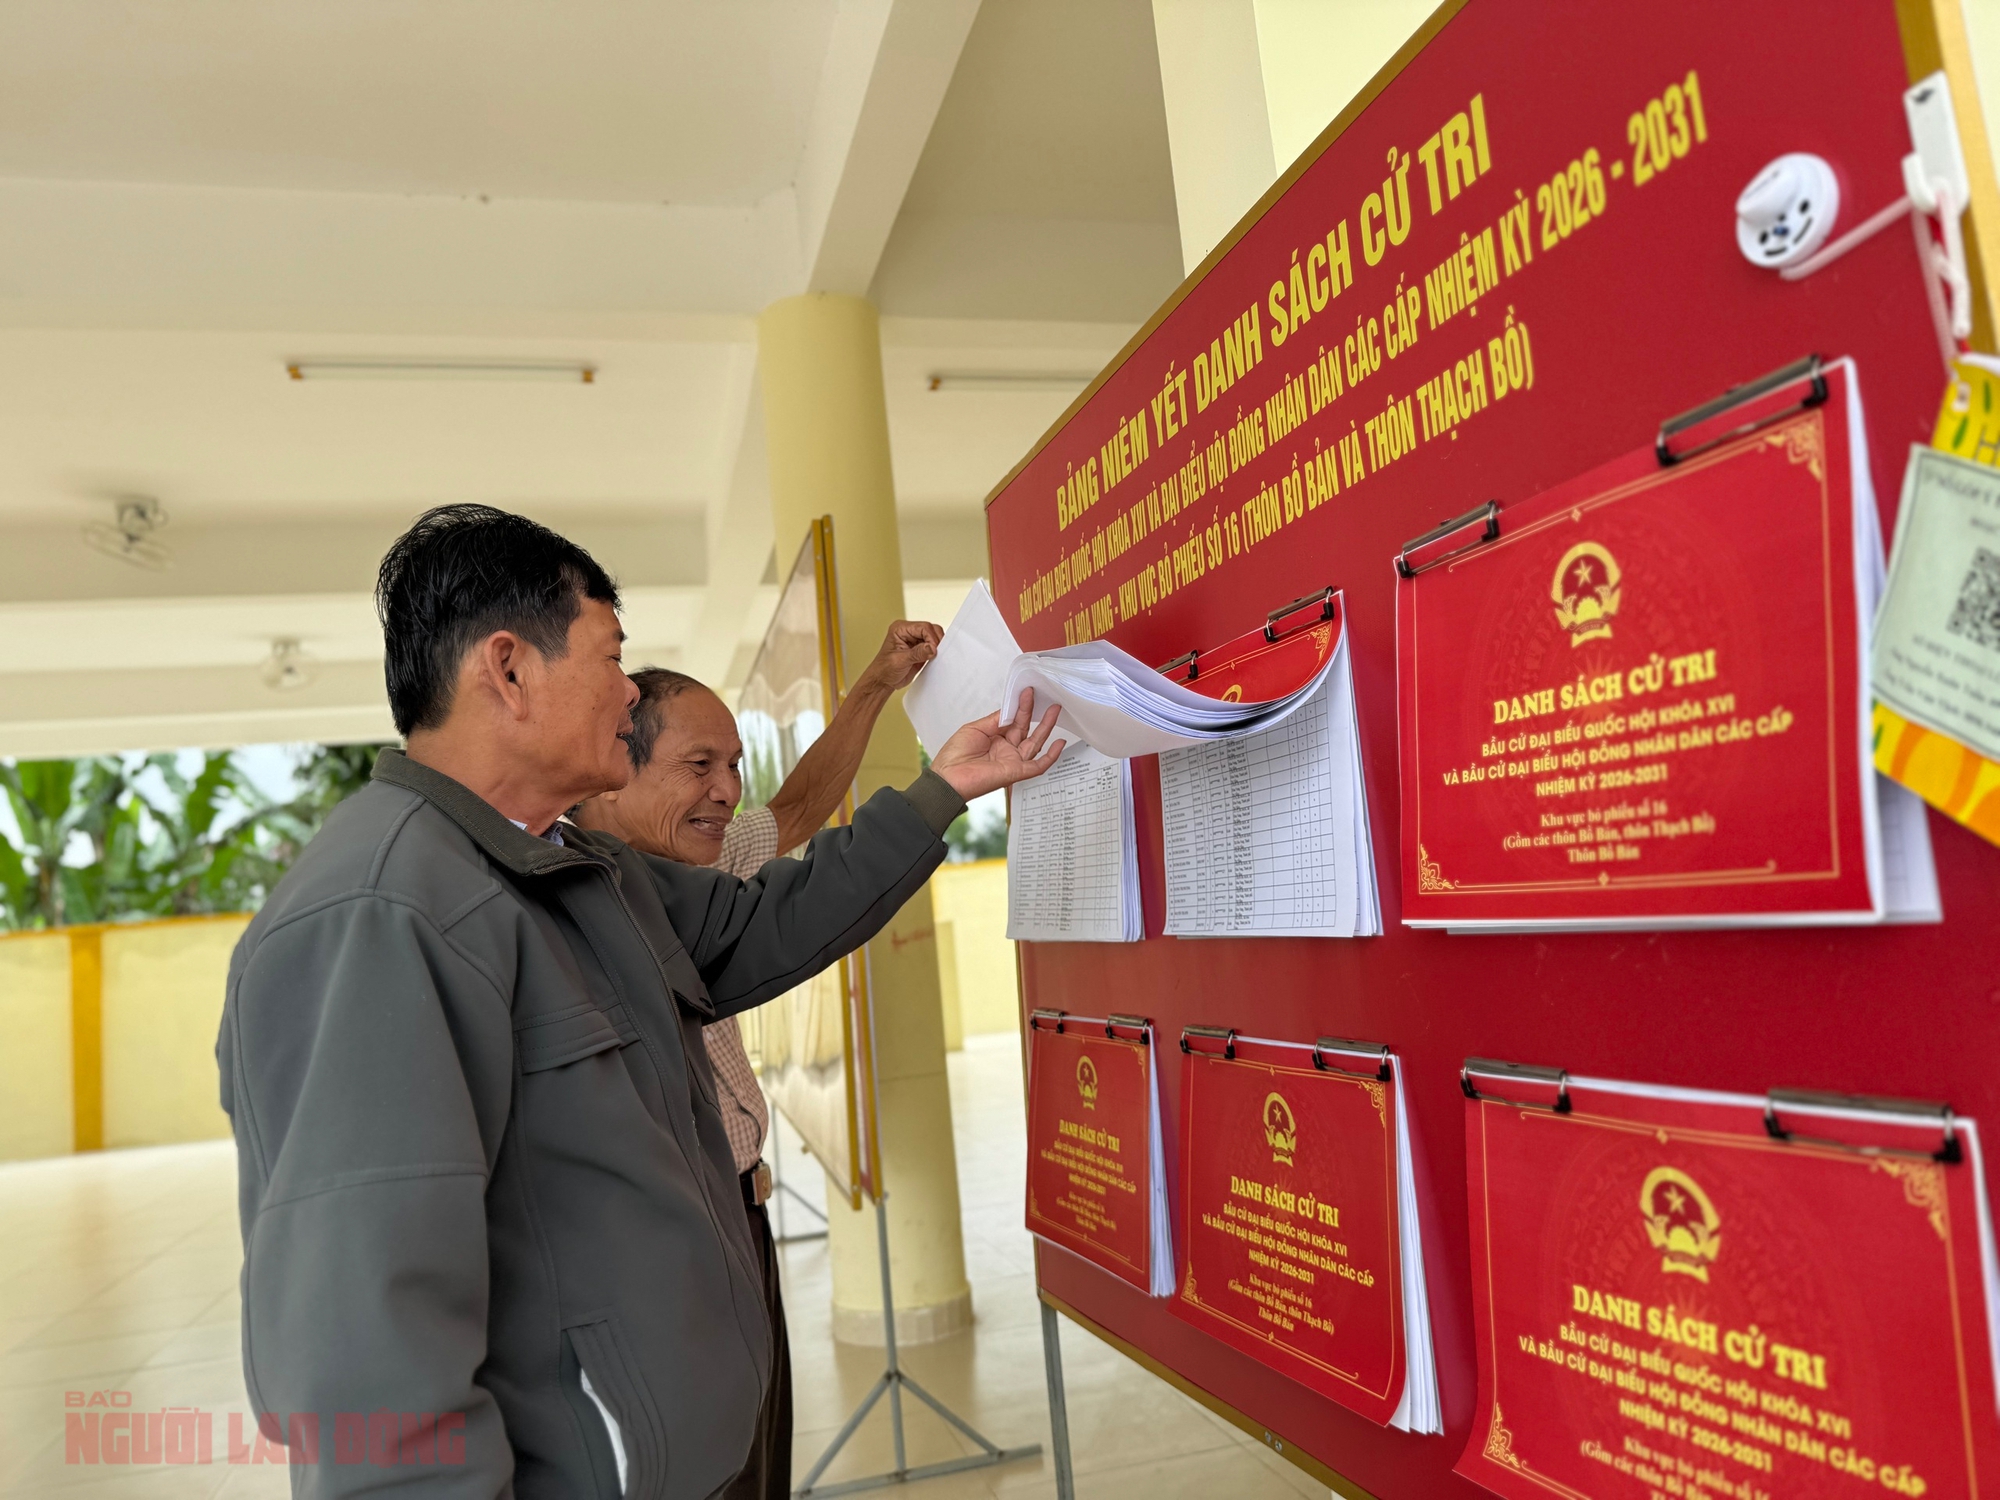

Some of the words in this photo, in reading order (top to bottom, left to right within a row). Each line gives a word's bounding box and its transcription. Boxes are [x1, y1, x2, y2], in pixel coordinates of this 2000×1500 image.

[1057, 457, 1099, 531] BẢNG
[1101, 408, 1149, 493] NIÊM
[1151, 361, 1187, 447] YẾT
[1194, 302, 1262, 414] DANH
[1269, 219, 1352, 346] SÁCH
[1360, 146, 1411, 266] CỬ
[1418, 94, 1491, 215] TRI
[1071, 534, 1092, 590] QUỐC
[1092, 526, 1107, 576] HỘI
[1106, 509, 1131, 562] KHÓA
[1130, 500, 1147, 544] XVI
[1146, 482, 1161, 532] VÀ
[1161, 474, 1180, 526] ĐẠI
[1180, 440, 1206, 508] BIỂU
[1206, 430, 1228, 492] HỘI
[1228, 406, 1265, 473] ĐỒNG
[1266, 373, 1307, 446] NHÂN
[1308, 346, 1343, 415] DÂN
[1345, 315, 1380, 387] CÁC
[1384, 272, 1420, 359] CẤP
[1425, 227, 1498, 330] NHIỆM
[1499, 189, 1532, 276] KỲ
[1537, 148, 1606, 250] 2026
[1628, 72, 1706, 186] 2031
[1075, 603, 1092, 644] HÒA
[1091, 594, 1113, 638] VANG
[1119, 578, 1138, 622] KHU
[1138, 564, 1157, 615] VỰC
[1158, 542, 1172, 599] BỎ
[1173, 524, 1205, 590] PHIẾU
[1206, 506, 1222, 570] SỐ
[1224, 512, 1240, 558] 16
[1242, 481, 1282, 553] (THÔN
[1282, 452, 1303, 524] BỒ
[1305, 438, 1339, 510] BẢN
[1339, 420, 1365, 488] VÀ
[1365, 394, 1416, 472] THÔN
[1416, 349, 1488, 442] THẠCH
[1488, 306, 1533, 400] BỒ)
[1482, 736, 1505, 756] BẦU
[1508, 732, 1526, 752] CỬ
[1529, 732, 1551, 750] ĐẠI
[1554, 720, 1581, 744] BIỂU
[1584, 714, 1625, 738] QUỐC
[1628, 708, 1656, 732] HỘI
[1658, 700, 1704, 725] KHÓA
[1707, 694, 1735, 716] XVI
[1494, 689, 1555, 724] DANH
[1560, 672, 1622, 710] SÁCH
[1628, 654, 1665, 695] CỬ
[1669, 650, 1716, 686] TRI
[1443, 769, 1459, 785] VÀ
[1462, 763, 1485, 783] BẦU
[1488, 760, 1506, 779] CỬ
[1508, 760, 1530, 778] ĐẠI
[1532, 750, 1558, 772] BIỂU
[1562, 748, 1586, 770] HỘI
[1588, 740, 1632, 764] ĐỒNG
[1633, 733, 1676, 756] NHÂN
[1678, 726, 1713, 750] DÂN
[1715, 718, 1753, 743] CÁC
[1755, 706, 1793, 736] CẤP
[1536, 776, 1576, 797] NHIỆM
[1578, 772, 1596, 791] KỲ
[1599, 764, 1667, 789] 2026-2031
[1231, 1176, 1262, 1202] DANH
[1265, 1184, 1295, 1212] SÁCH
[1298, 1192, 1316, 1218] CỬ
[1317, 1203, 1338, 1227] TRI
[1249, 1249, 1269, 1266] NHIỆM
[1269, 1256, 1279, 1270] KỲ
[1280, 1262, 1314, 1284] 2026-2031
[1573, 1285, 1642, 1330] DANH
[1647, 1305, 1718, 1354] SÁCH
[1724, 1325, 1766, 1368] CỬ
[1770, 1344, 1826, 1389] TRI
[1519, 1336, 1537, 1355] VÀ
[1539, 1340, 1564, 1364] BẦU
[1566, 1352, 1587, 1373] CỬ
[1588, 1360, 1614, 1384] ĐẠI
[1616, 1368, 1646, 1394] BIỂU
[1648, 1382, 1677, 1407] HỘI
[1679, 1391, 1729, 1425] ĐỒNG
[1731, 1412, 1782, 1445] NHÂN
[1784, 1430, 1826, 1462] DÂN
[1828, 1447, 1876, 1480] CÁC
[1879, 1466, 1926, 1497] CẤP
[1560, 1321, 1586, 1346] BẦU
[1588, 1333, 1610, 1354] CỬ
[1611, 1342, 1637, 1370] ĐẠI
[1639, 1349, 1671, 1376] BIỂU
[1673, 1363, 1722, 1393] QUỐC
[1725, 1380, 1757, 1407] HỘI
[1760, 1392, 1813, 1426] KHÓA
[1817, 1410, 1851, 1438] XVI
[1620, 1399, 1665, 1430] NHIỆM
[1668, 1417, 1688, 1438] KỲ
[1692, 1426, 1772, 1472] 2026-2031
